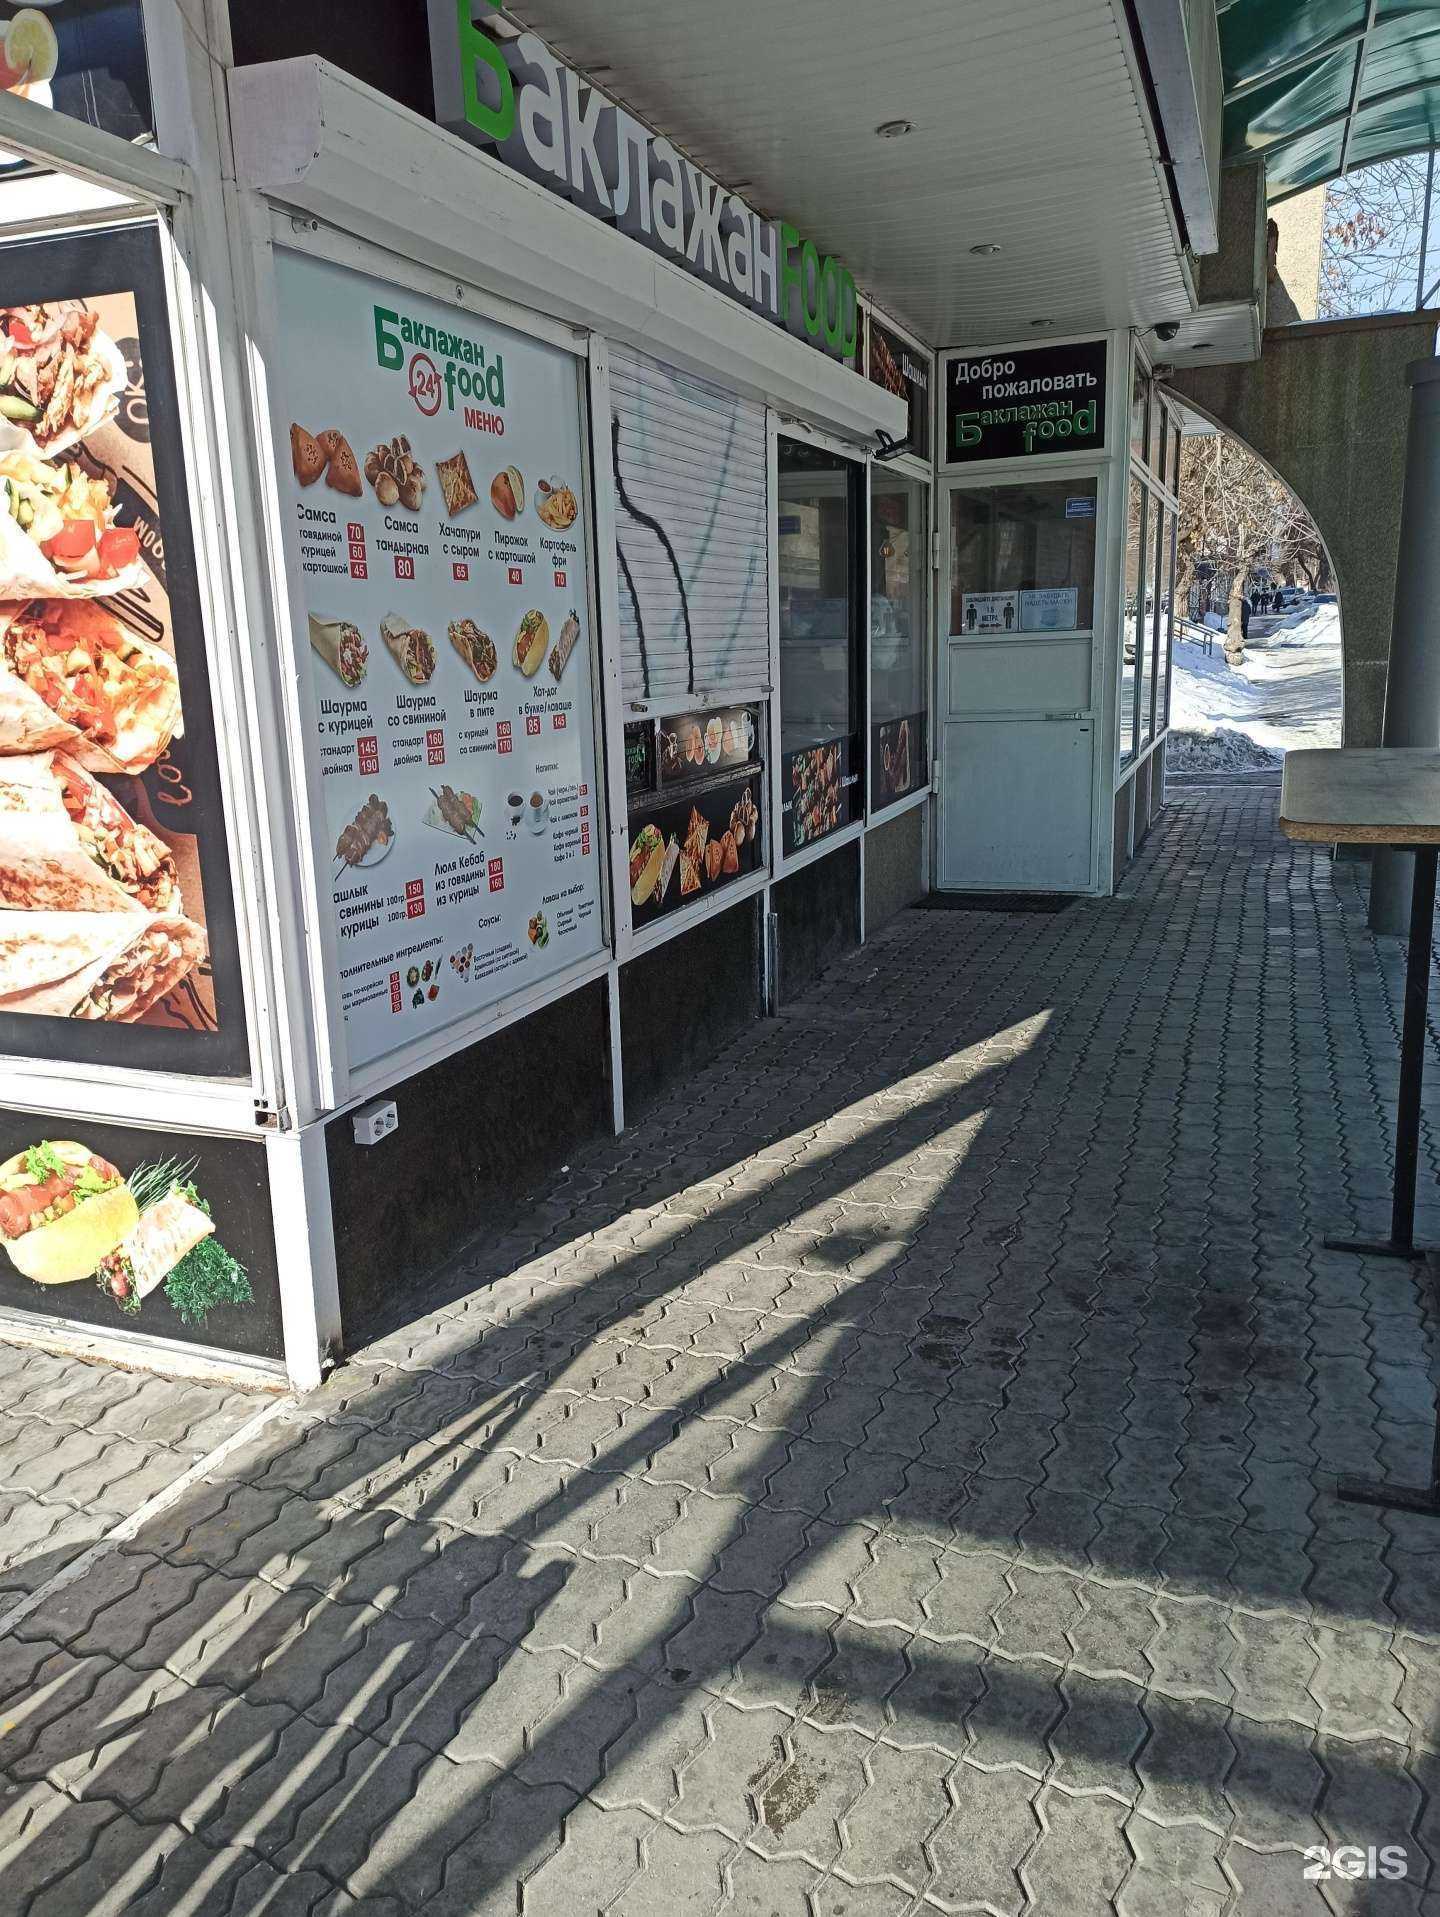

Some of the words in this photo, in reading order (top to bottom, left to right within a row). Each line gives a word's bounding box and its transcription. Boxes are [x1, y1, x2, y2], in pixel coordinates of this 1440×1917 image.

[457, 0, 778, 314] Баклажан
[373, 305, 485, 371] Баклажан
[955, 358, 1016, 385] Добро
[417, 370, 435, 398] 24
[444, 354, 505, 411] food
[982, 371, 1098, 399] пожаловать
[464, 406, 505, 436] МЕНЮ
[955, 400, 1073, 448] Баклажан
[1023, 400, 1097, 453] food
[384, 515, 419, 533] Самса
[439, 522, 481, 543] Хачапури
[300, 529, 342, 542] говядиной
[349, 525, 362, 537] 70
[494, 530, 529, 547] Пирожок
[301, 546, 336, 559] курицей
[352, 546, 363, 558] 60
[376, 539, 430, 556] тандырная
[443, 546, 449, 555] с
[450, 545, 480, 559] сыром
[539, 537, 577, 554] Картофель
[488, 551, 494, 561] с
[495, 549, 536, 565] картошкой
[552, 554, 567, 570] фри
[302, 562, 349, 577] картошкой
[353, 565, 365, 577] 45
[397, 560, 411, 577] 80
[456, 565, 466, 578] 65
[511, 571, 520, 582] 40
[464, 690, 498, 704] Шаурма
[533, 686, 558, 698] Хот-дог
[320, 699, 368, 717] Шаурма
[396, 695, 436, 711] Шаурма
[519, 706, 523, 715] в
[387, 715, 400, 727] со
[403, 709, 446, 725] свининой
[470, 708, 475, 718] в
[478, 706, 495, 717] пите
[318, 721, 325, 733] с
[328, 714, 373, 735] курицей
[528, 719, 539, 733] 85
[392, 736, 424, 749] стандарт
[428, 732, 442, 745] 160
[464, 728, 489, 740] курицей
[360, 741, 376, 754] 145
[361, 759, 377, 772] 190
[393, 754, 422, 767] двойная
[429, 750, 443, 763] 240
[434, 862, 457, 877] Люля
[459, 850, 485, 868] Кебаб
[435, 880, 446, 892] из
[448, 868, 486, 887] говядины
[339, 895, 384, 920] свинины
[408, 882, 421, 895] 150
[436, 895, 447, 907] из
[450, 885, 480, 905] курицы
[340, 916, 380, 939] курицы
[409, 902, 423, 916] 130
[478, 914, 502, 929] Соусы:
[396, 936, 444, 958] ингредиенты:
